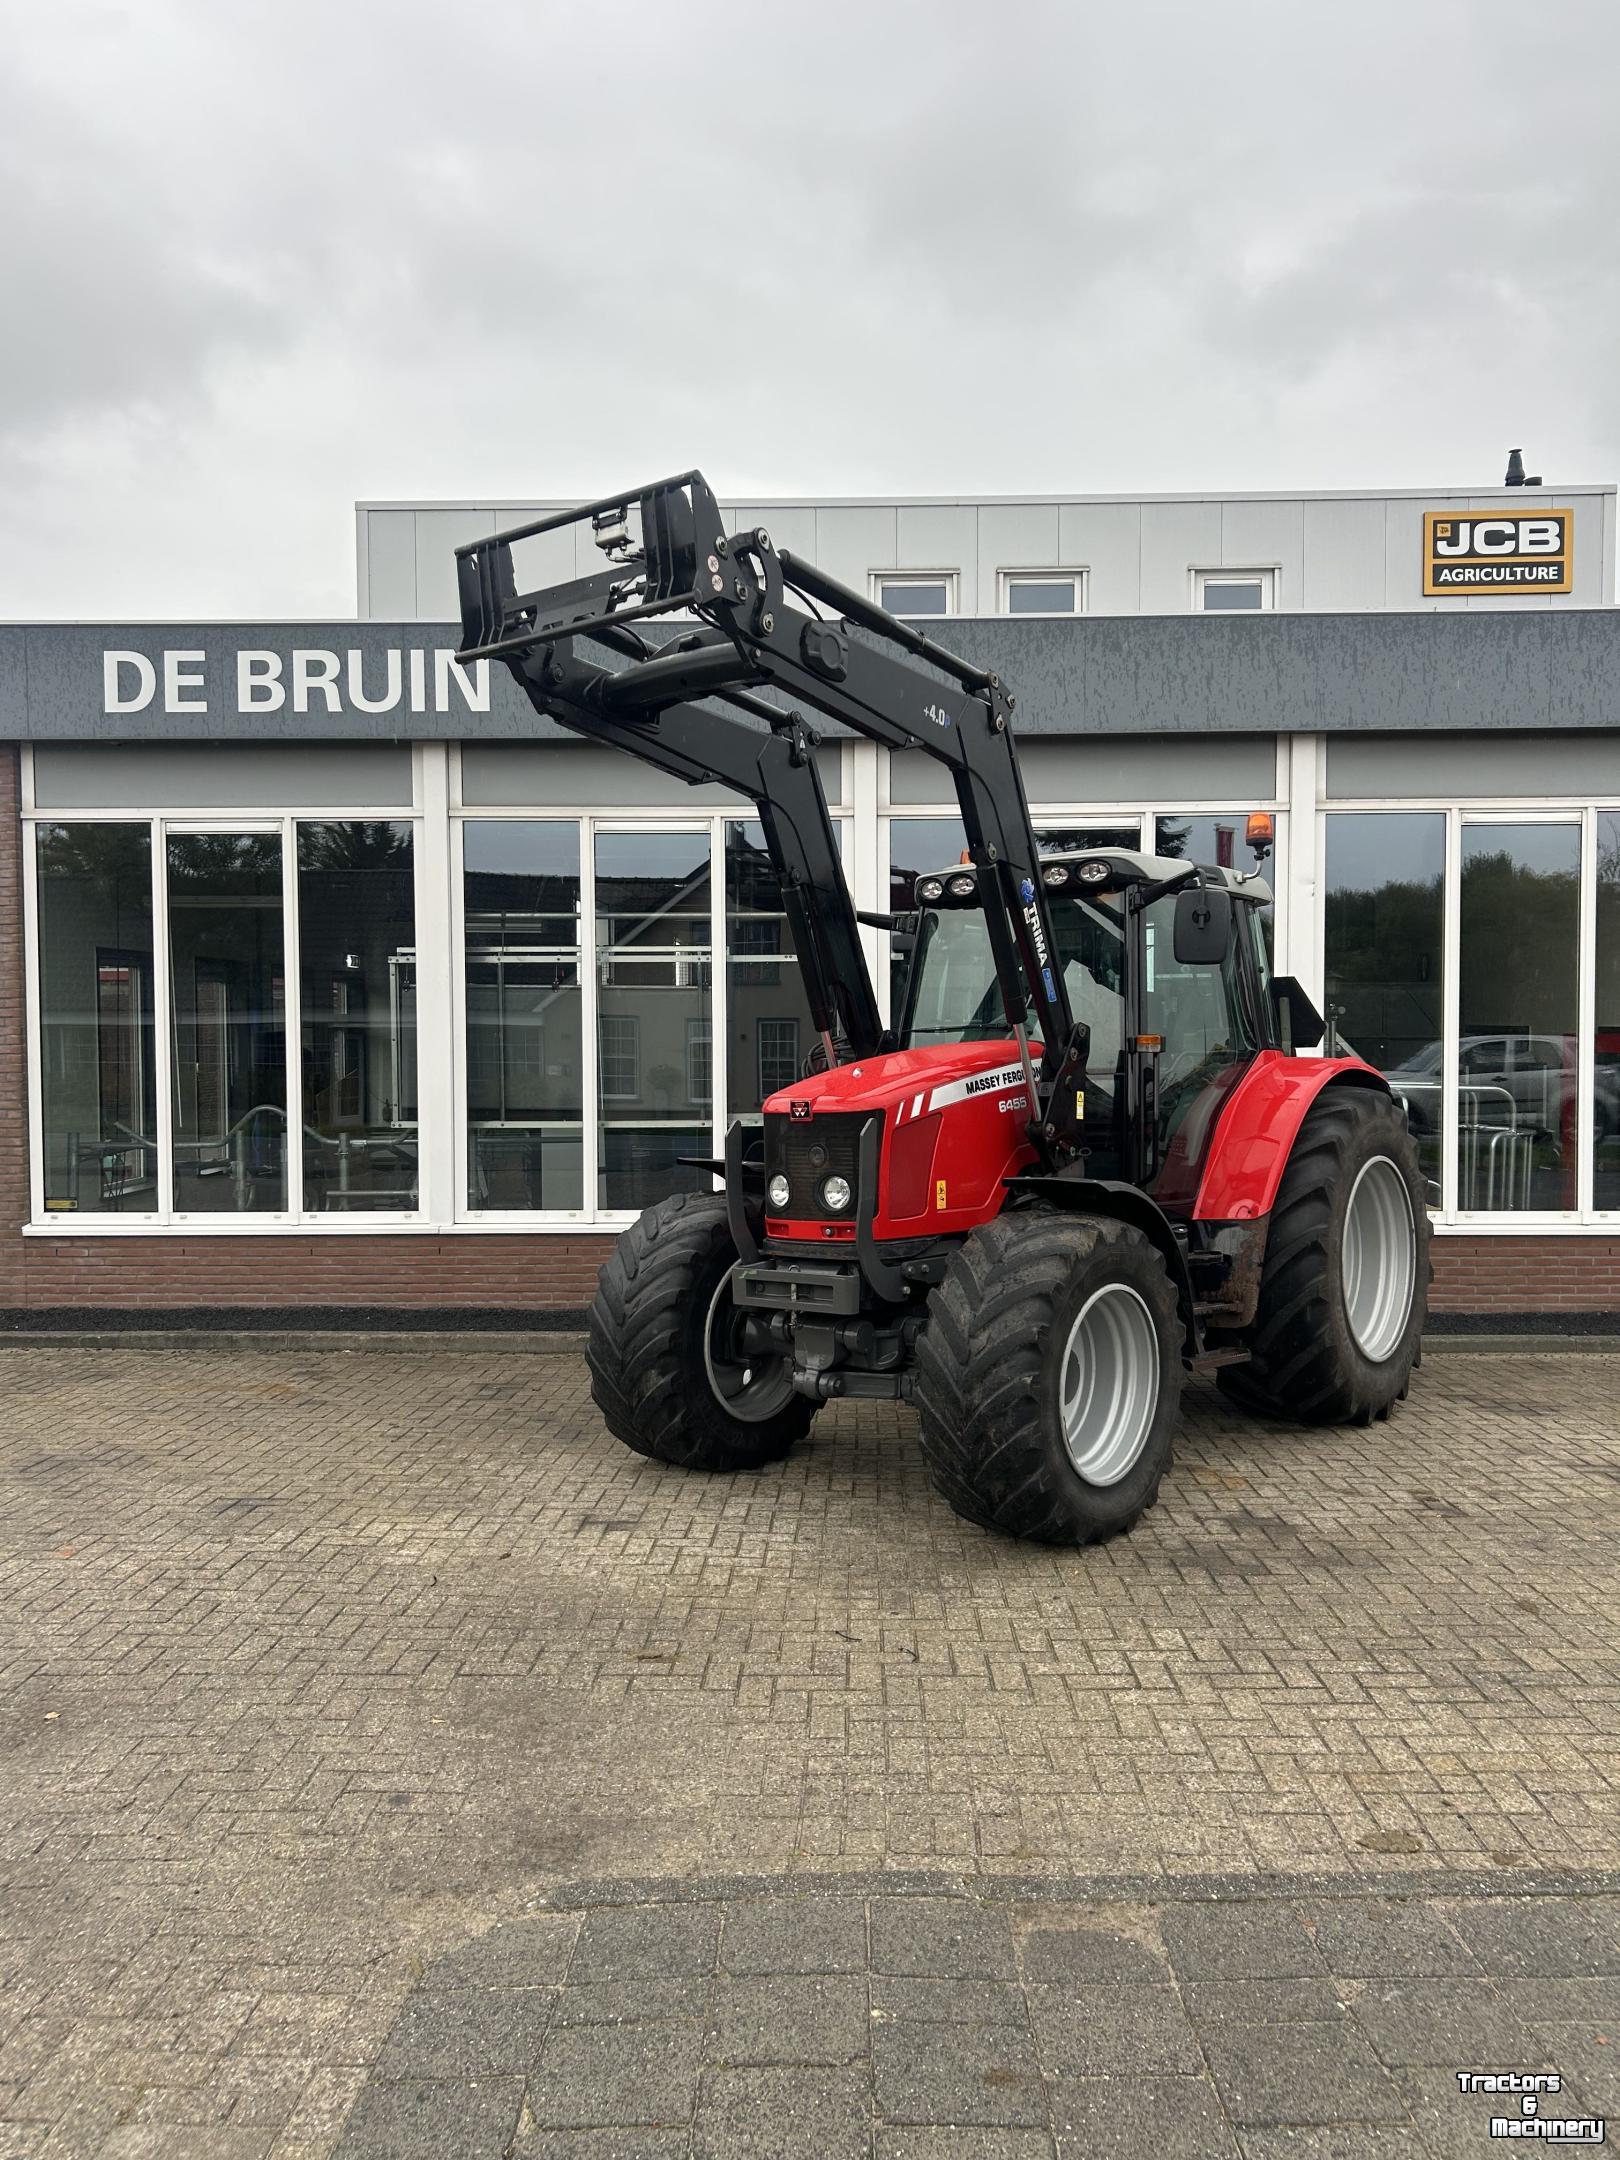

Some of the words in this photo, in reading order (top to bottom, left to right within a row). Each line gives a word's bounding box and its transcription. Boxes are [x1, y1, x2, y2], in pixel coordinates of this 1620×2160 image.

[1437, 520, 1561, 556] JCB
[1438, 566, 1558, 582] AGRICULTURE
[103, 650, 208, 713] DE
[237, 649, 491, 713] BRUIN
[1028, 901, 1048, 968] TRIMA
[965, 1074, 1001, 1095] MASSEY
[1002, 1066, 1041, 1085] FERGON
[998, 1097, 1027, 1113] 6455
